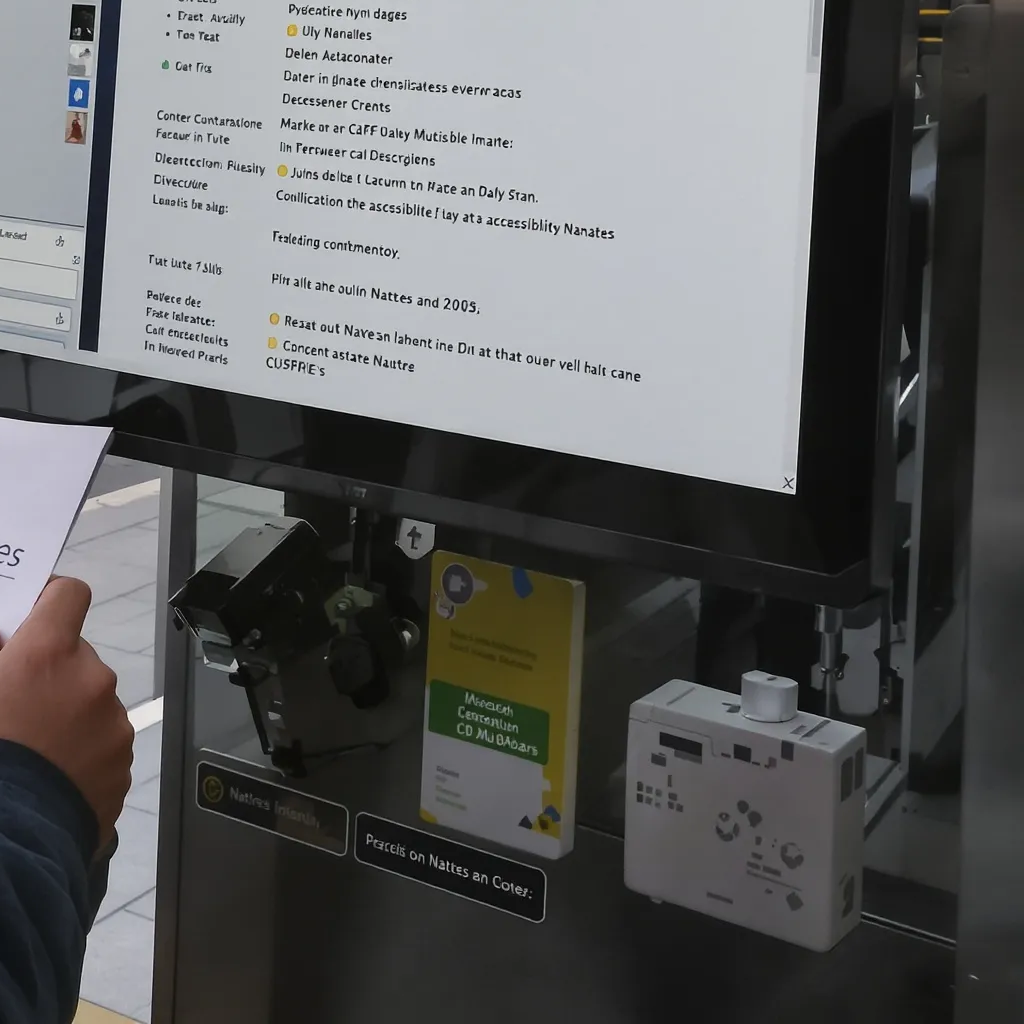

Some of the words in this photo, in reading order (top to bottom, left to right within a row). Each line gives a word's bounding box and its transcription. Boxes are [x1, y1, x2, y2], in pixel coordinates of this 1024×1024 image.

[319, 73, 329, 84] in
[461, 186, 475, 197] an
[347, 198, 365, 210] the
[371, 288, 412, 304] Nattes
[417, 297, 439, 309] and
[320, 323, 340, 335] out
[479, 347, 491, 358] at
[495, 348, 522, 363] that
[611, 369, 641, 382] cane
[409, 850, 425, 864] on
